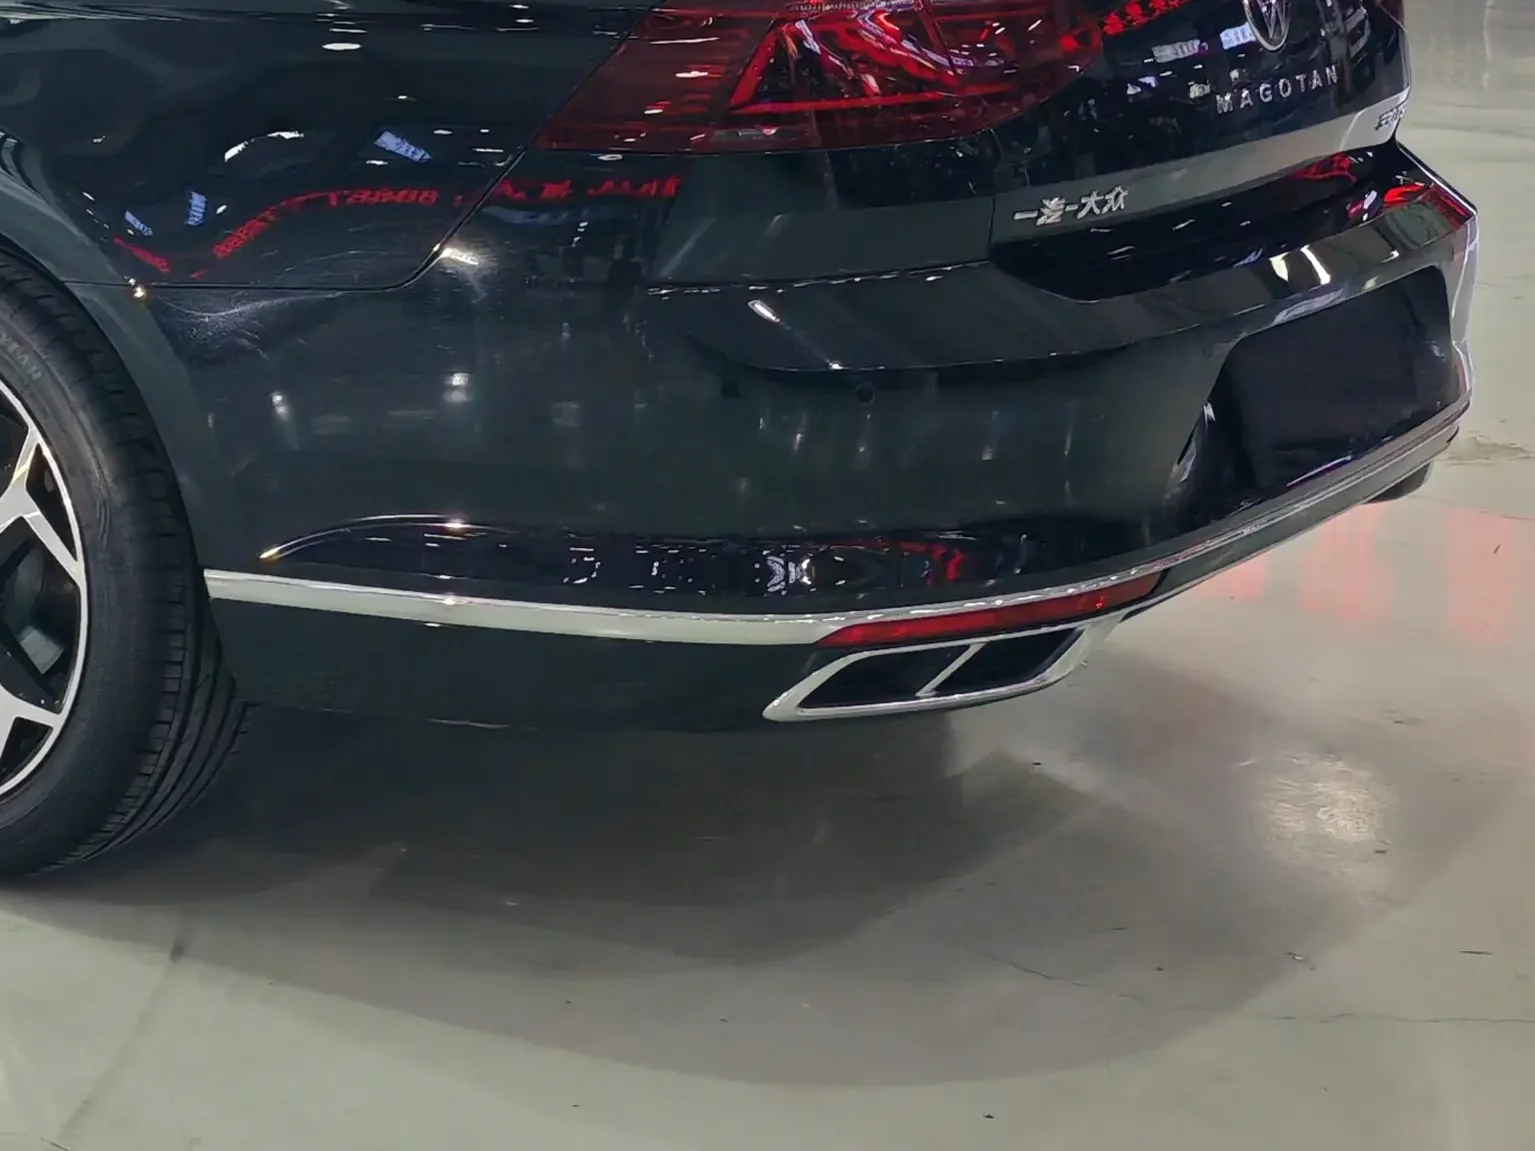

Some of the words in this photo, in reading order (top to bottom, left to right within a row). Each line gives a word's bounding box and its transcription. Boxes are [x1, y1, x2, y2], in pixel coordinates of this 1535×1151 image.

[1215, 64, 1339, 114] MAGOTAN
[1013, 186, 1129, 226] 一汽-大众
